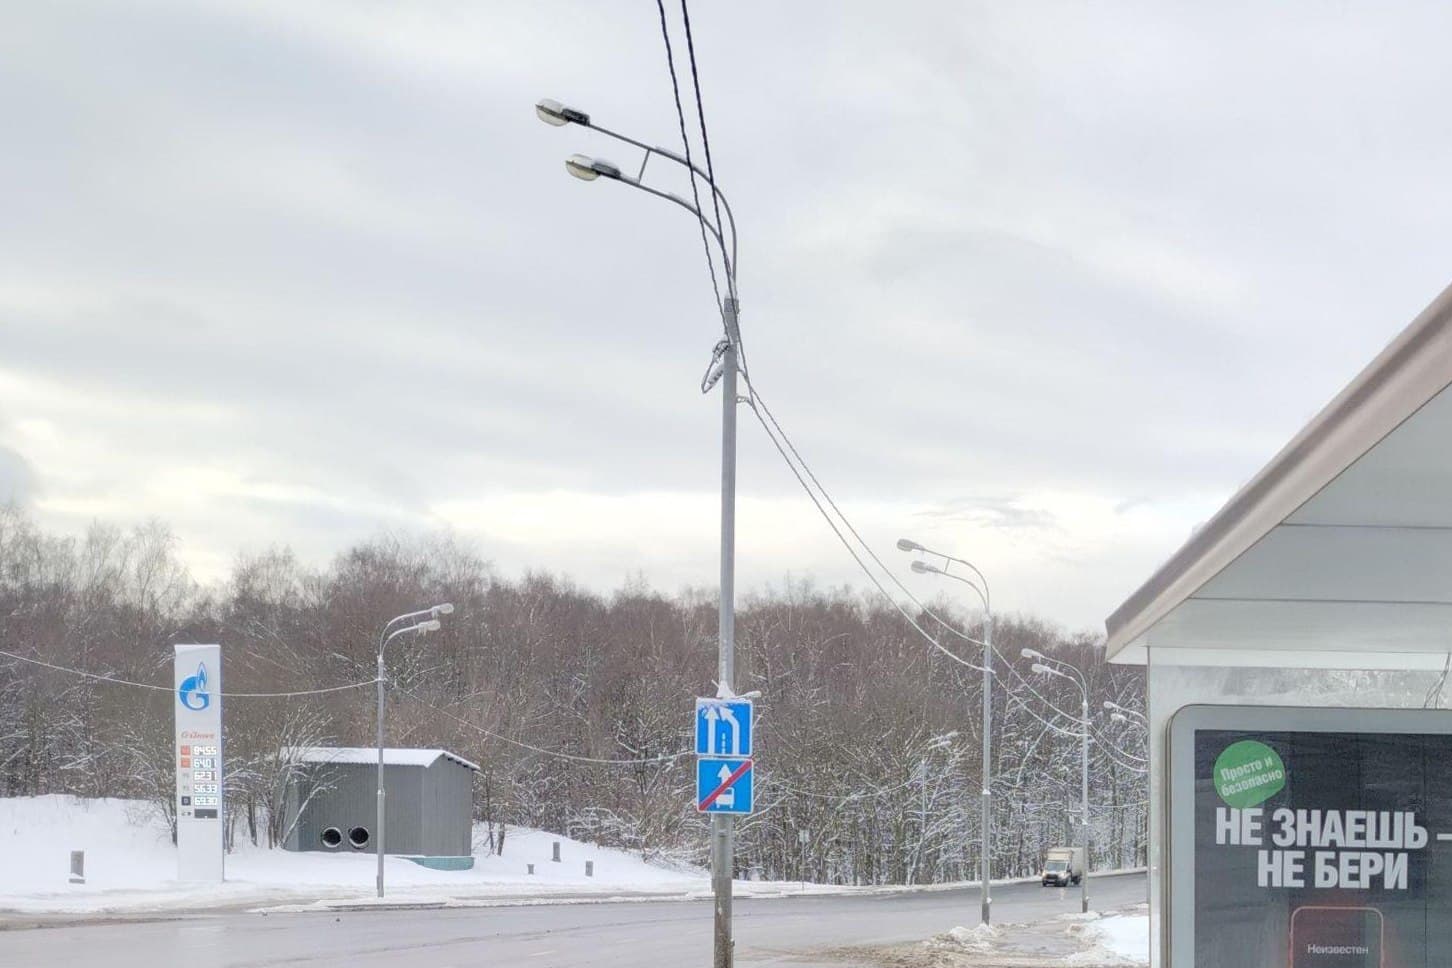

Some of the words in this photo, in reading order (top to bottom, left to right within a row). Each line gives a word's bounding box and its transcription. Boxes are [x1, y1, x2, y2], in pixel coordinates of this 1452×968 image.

[1220, 760, 1263, 781] Просто
[1264, 756, 1273, 768] и
[1221, 769, 1283, 797] безопасно
[1216, 807, 1263, 845] НЕ
[1272, 808, 1429, 850] ЗНАЕШЬ
[1257, 850, 1305, 888] НЕ
[1315, 852, 1408, 890] БЕРИ
[1307, 943, 1369, 955] Неизвестен
